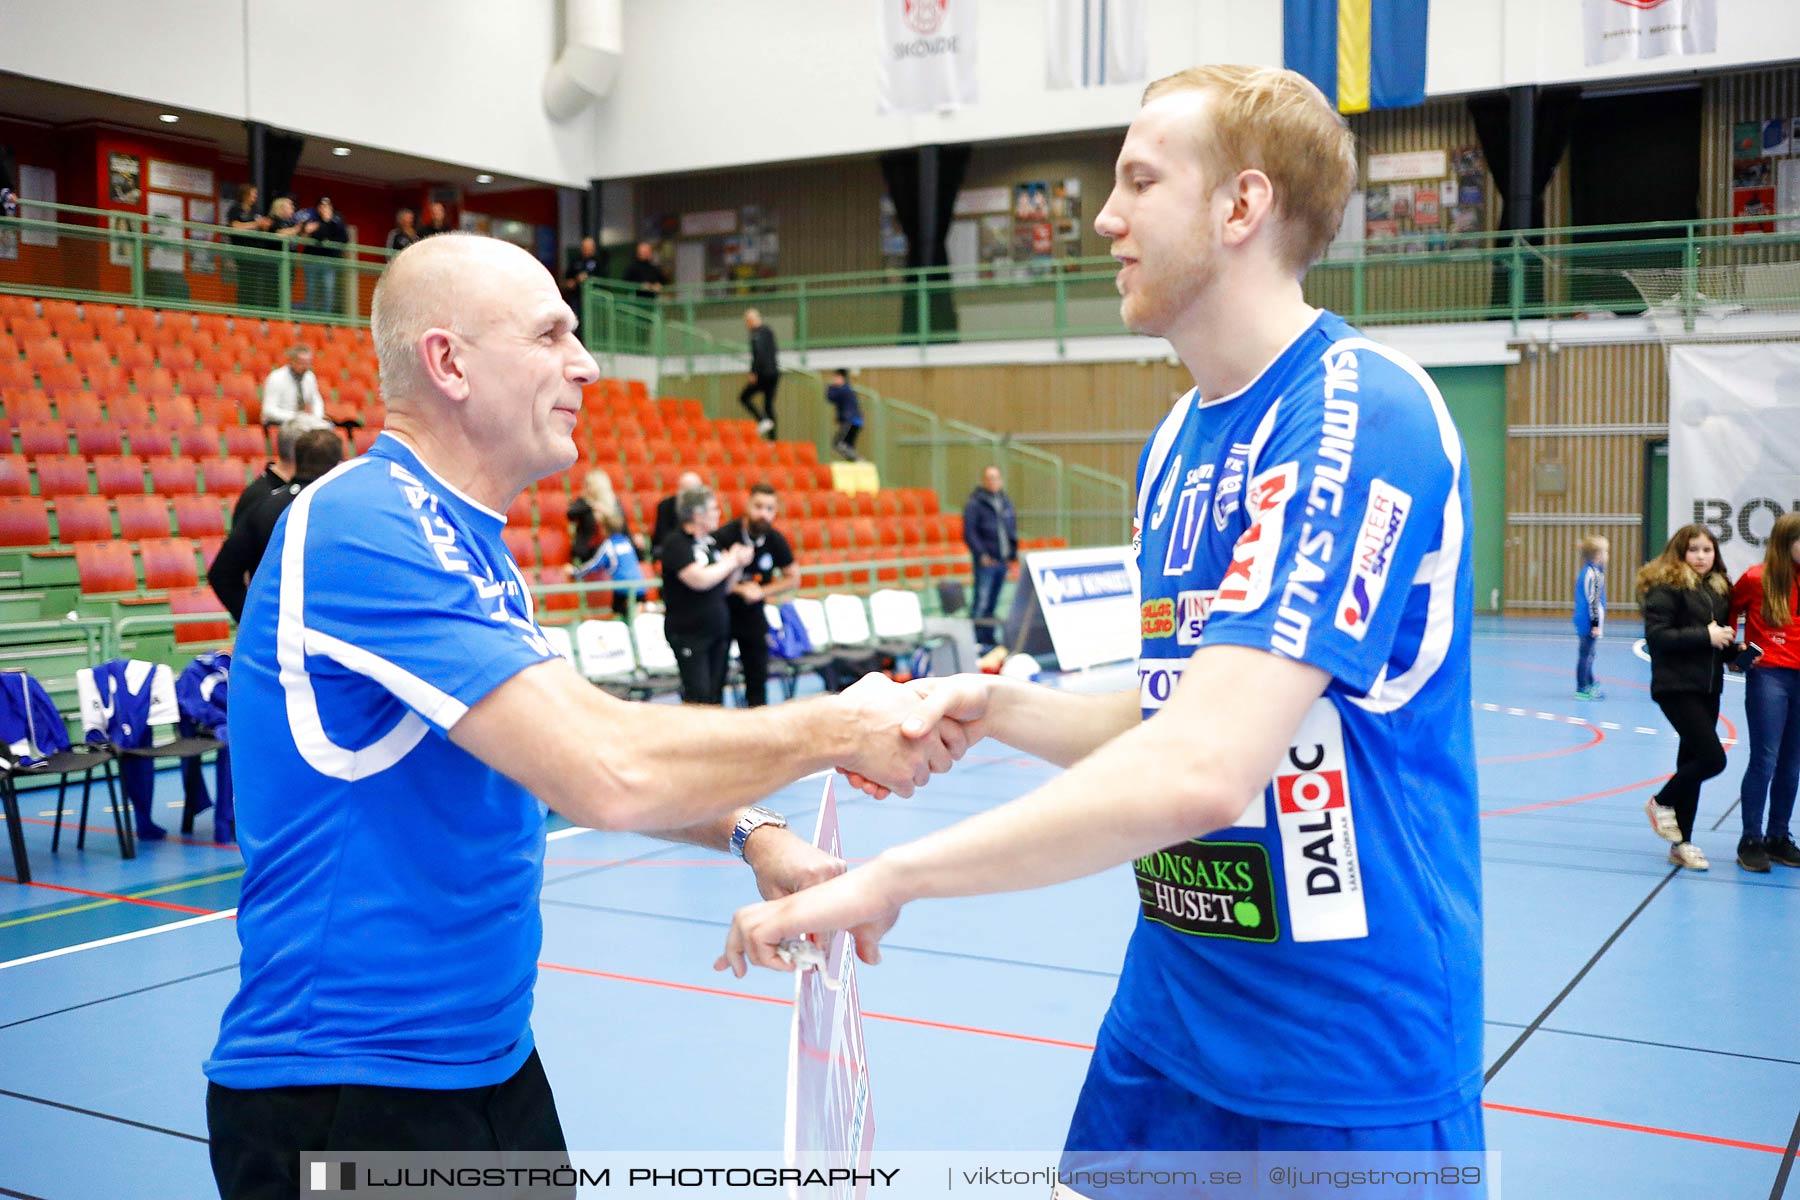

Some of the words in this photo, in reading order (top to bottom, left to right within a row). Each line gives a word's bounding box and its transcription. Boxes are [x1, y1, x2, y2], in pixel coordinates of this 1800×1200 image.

[1359, 494, 1390, 572] INTER
[1371, 501, 1403, 577] SPORT
[1693, 497, 1800, 549] BO
[1289, 743, 1342, 897] DALOC
[1153, 881, 1236, 924] HUSET
